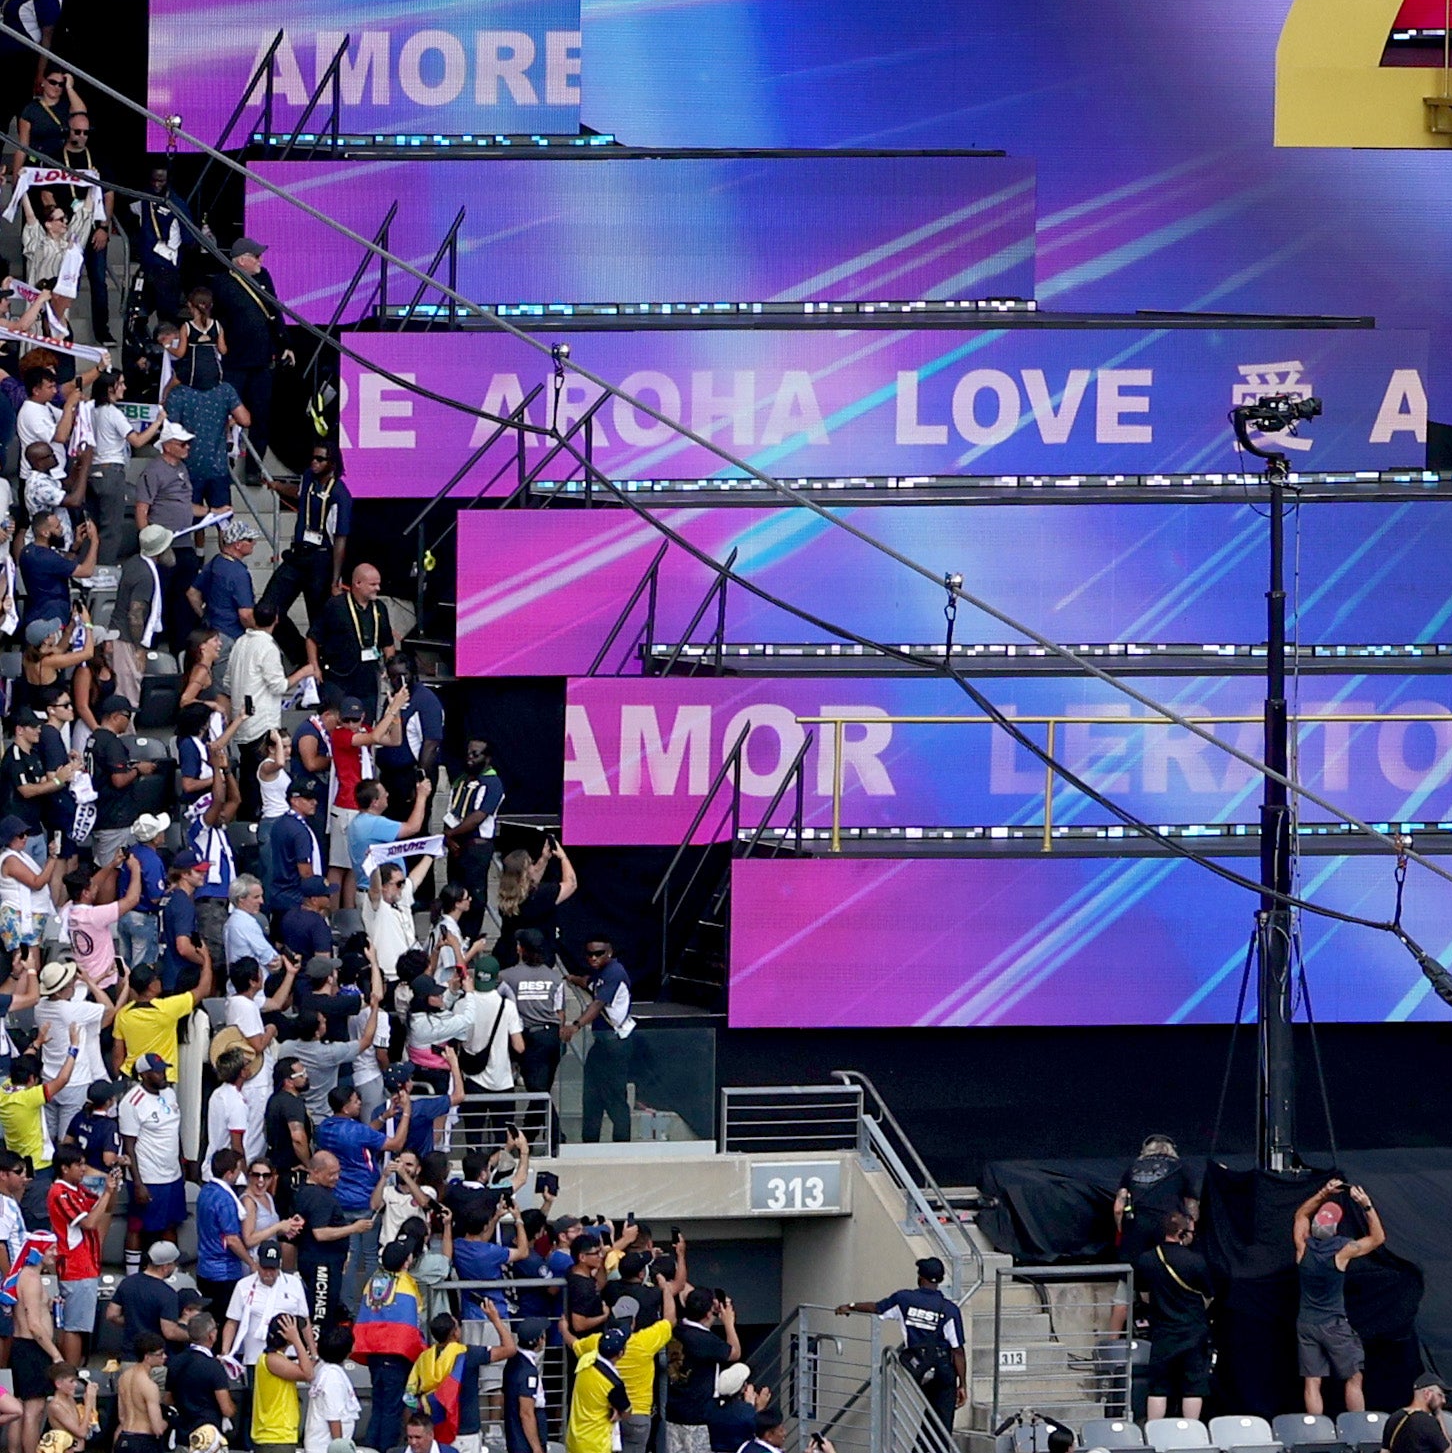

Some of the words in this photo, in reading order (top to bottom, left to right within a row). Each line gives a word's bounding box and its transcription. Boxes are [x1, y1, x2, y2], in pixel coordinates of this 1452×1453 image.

[246, 30, 581, 107] AMORE
[469, 370, 831, 449] AROHA
[895, 368, 1154, 445] LOVE
[1368, 368, 1428, 443] A
[564, 702, 897, 797] AMOR
[518, 980, 553, 990] BEST
[767, 1177, 824, 1211] 313
[314, 1266, 328, 1321] MICHAEL
[906, 1307, 945, 1322] BEST
[1001, 1352, 1023, 1365] 313
